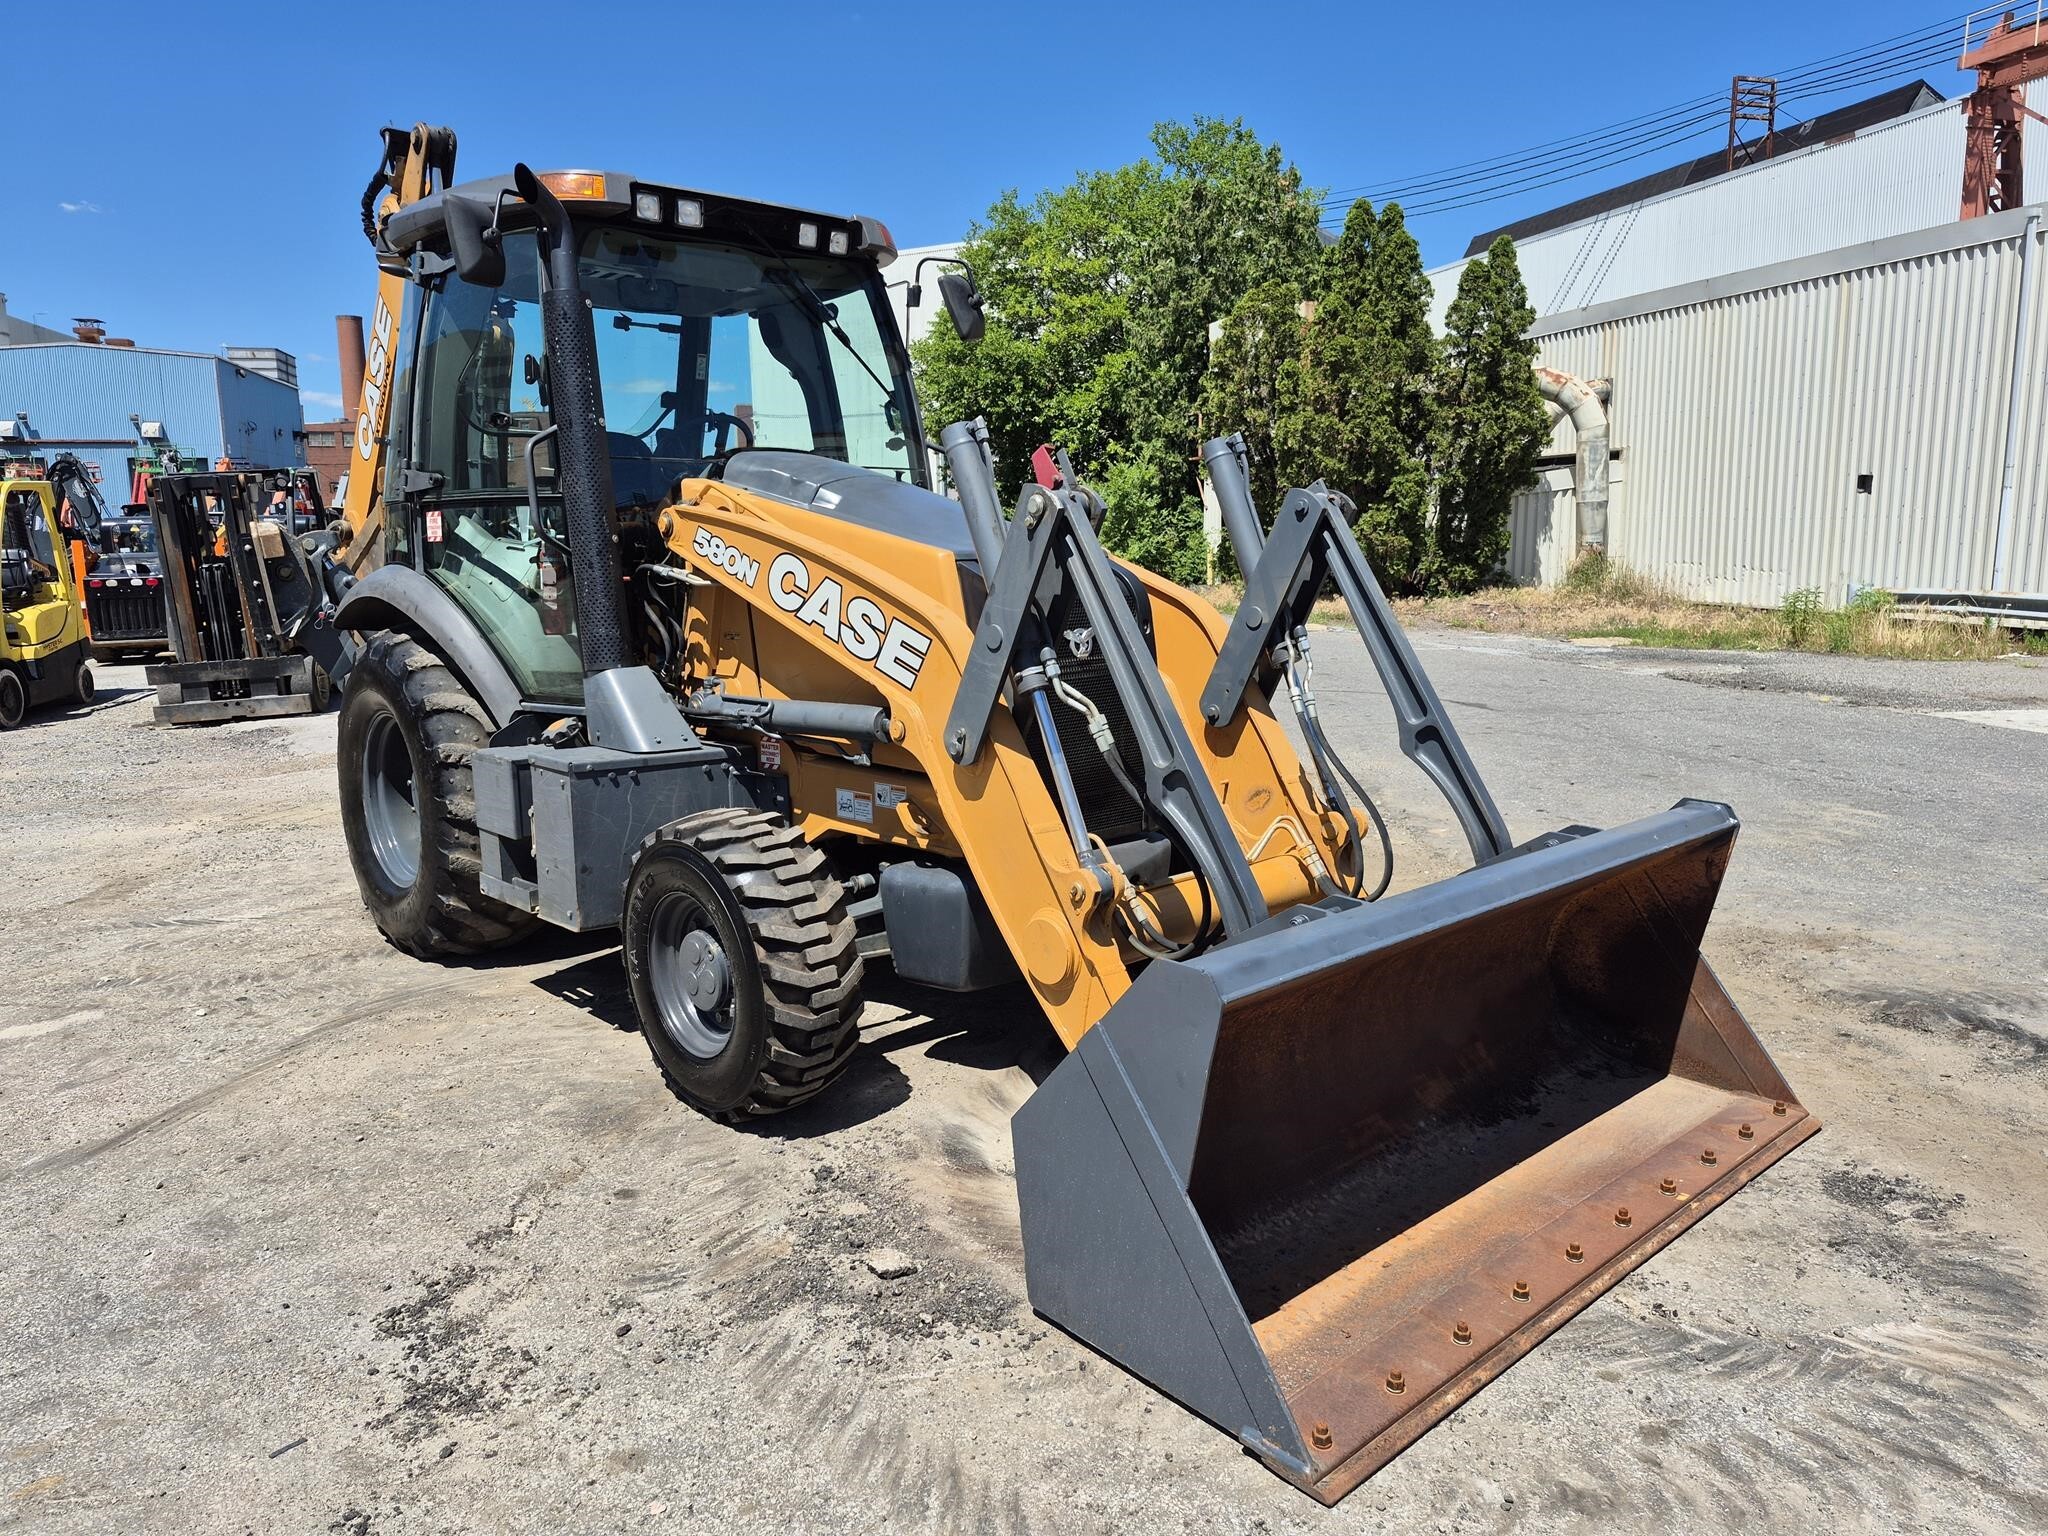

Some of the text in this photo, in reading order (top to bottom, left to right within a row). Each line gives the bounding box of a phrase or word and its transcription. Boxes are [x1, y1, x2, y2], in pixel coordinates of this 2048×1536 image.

[358, 291, 393, 461] CASE
[692, 525, 760, 587] 580N
[767, 551, 932, 691] CASE
